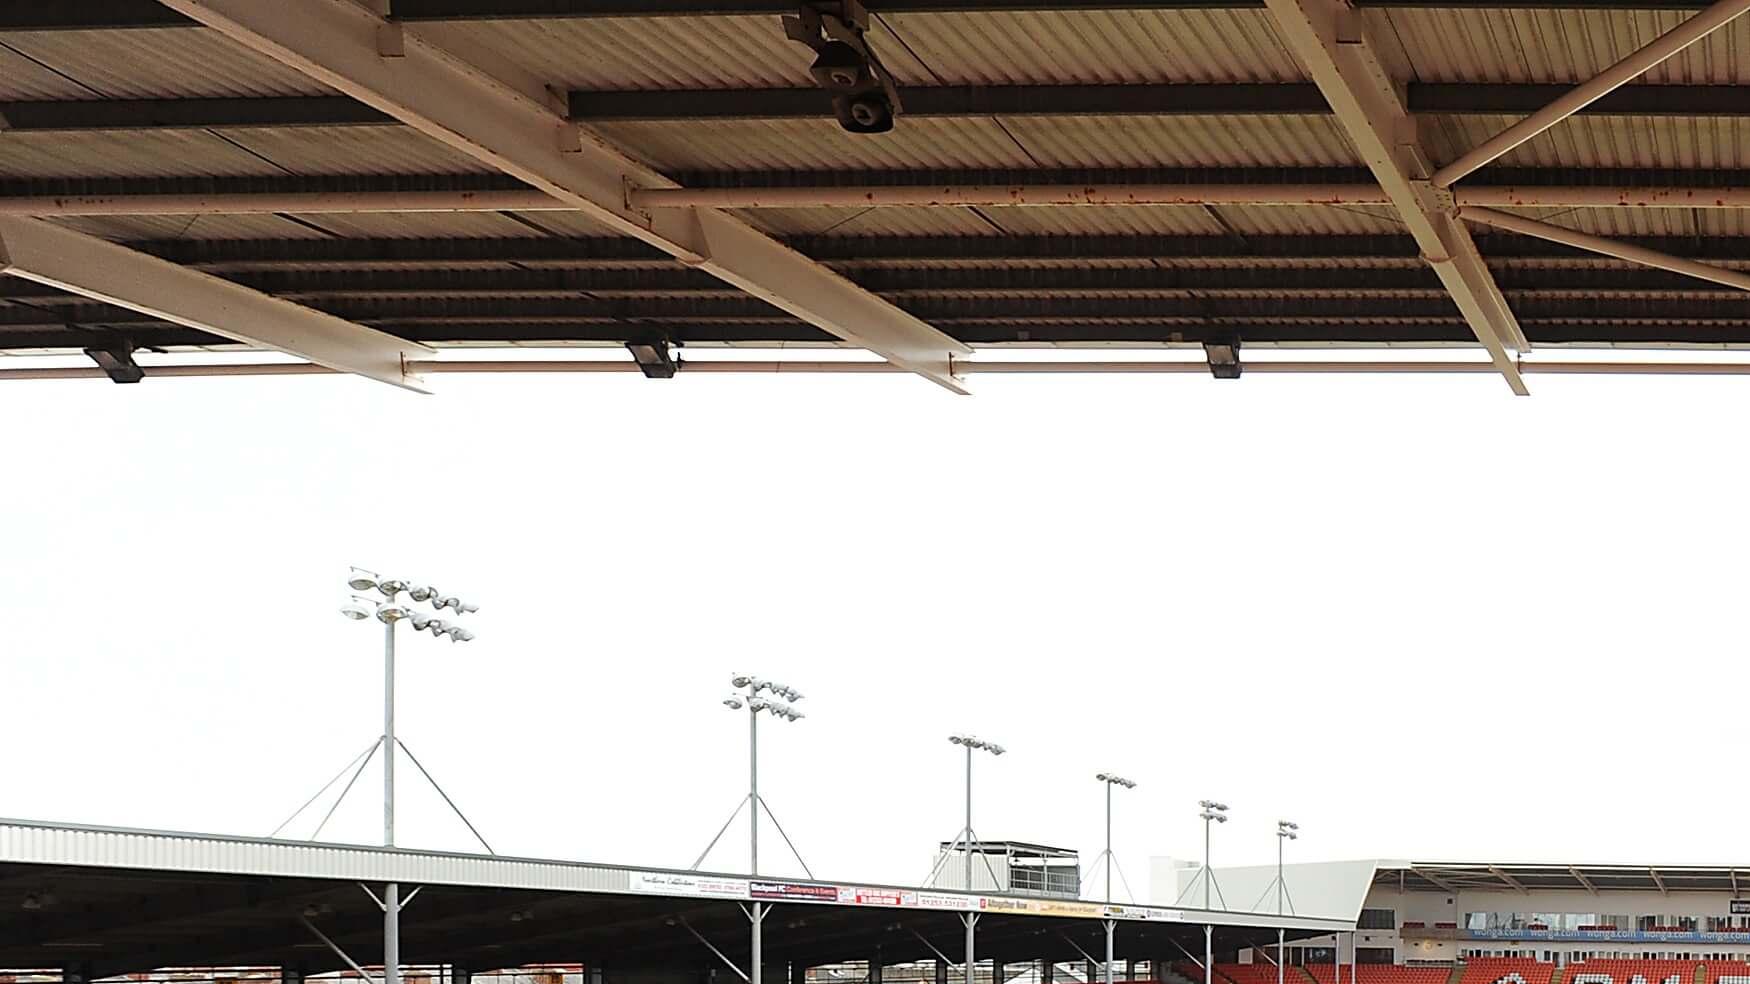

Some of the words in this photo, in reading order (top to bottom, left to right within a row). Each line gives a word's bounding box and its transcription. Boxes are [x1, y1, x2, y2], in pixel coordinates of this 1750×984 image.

[1475, 929, 1523, 937] wonga.com
[1587, 930, 1637, 939] wonga.com
[1700, 932, 1750, 942] wonga.com
